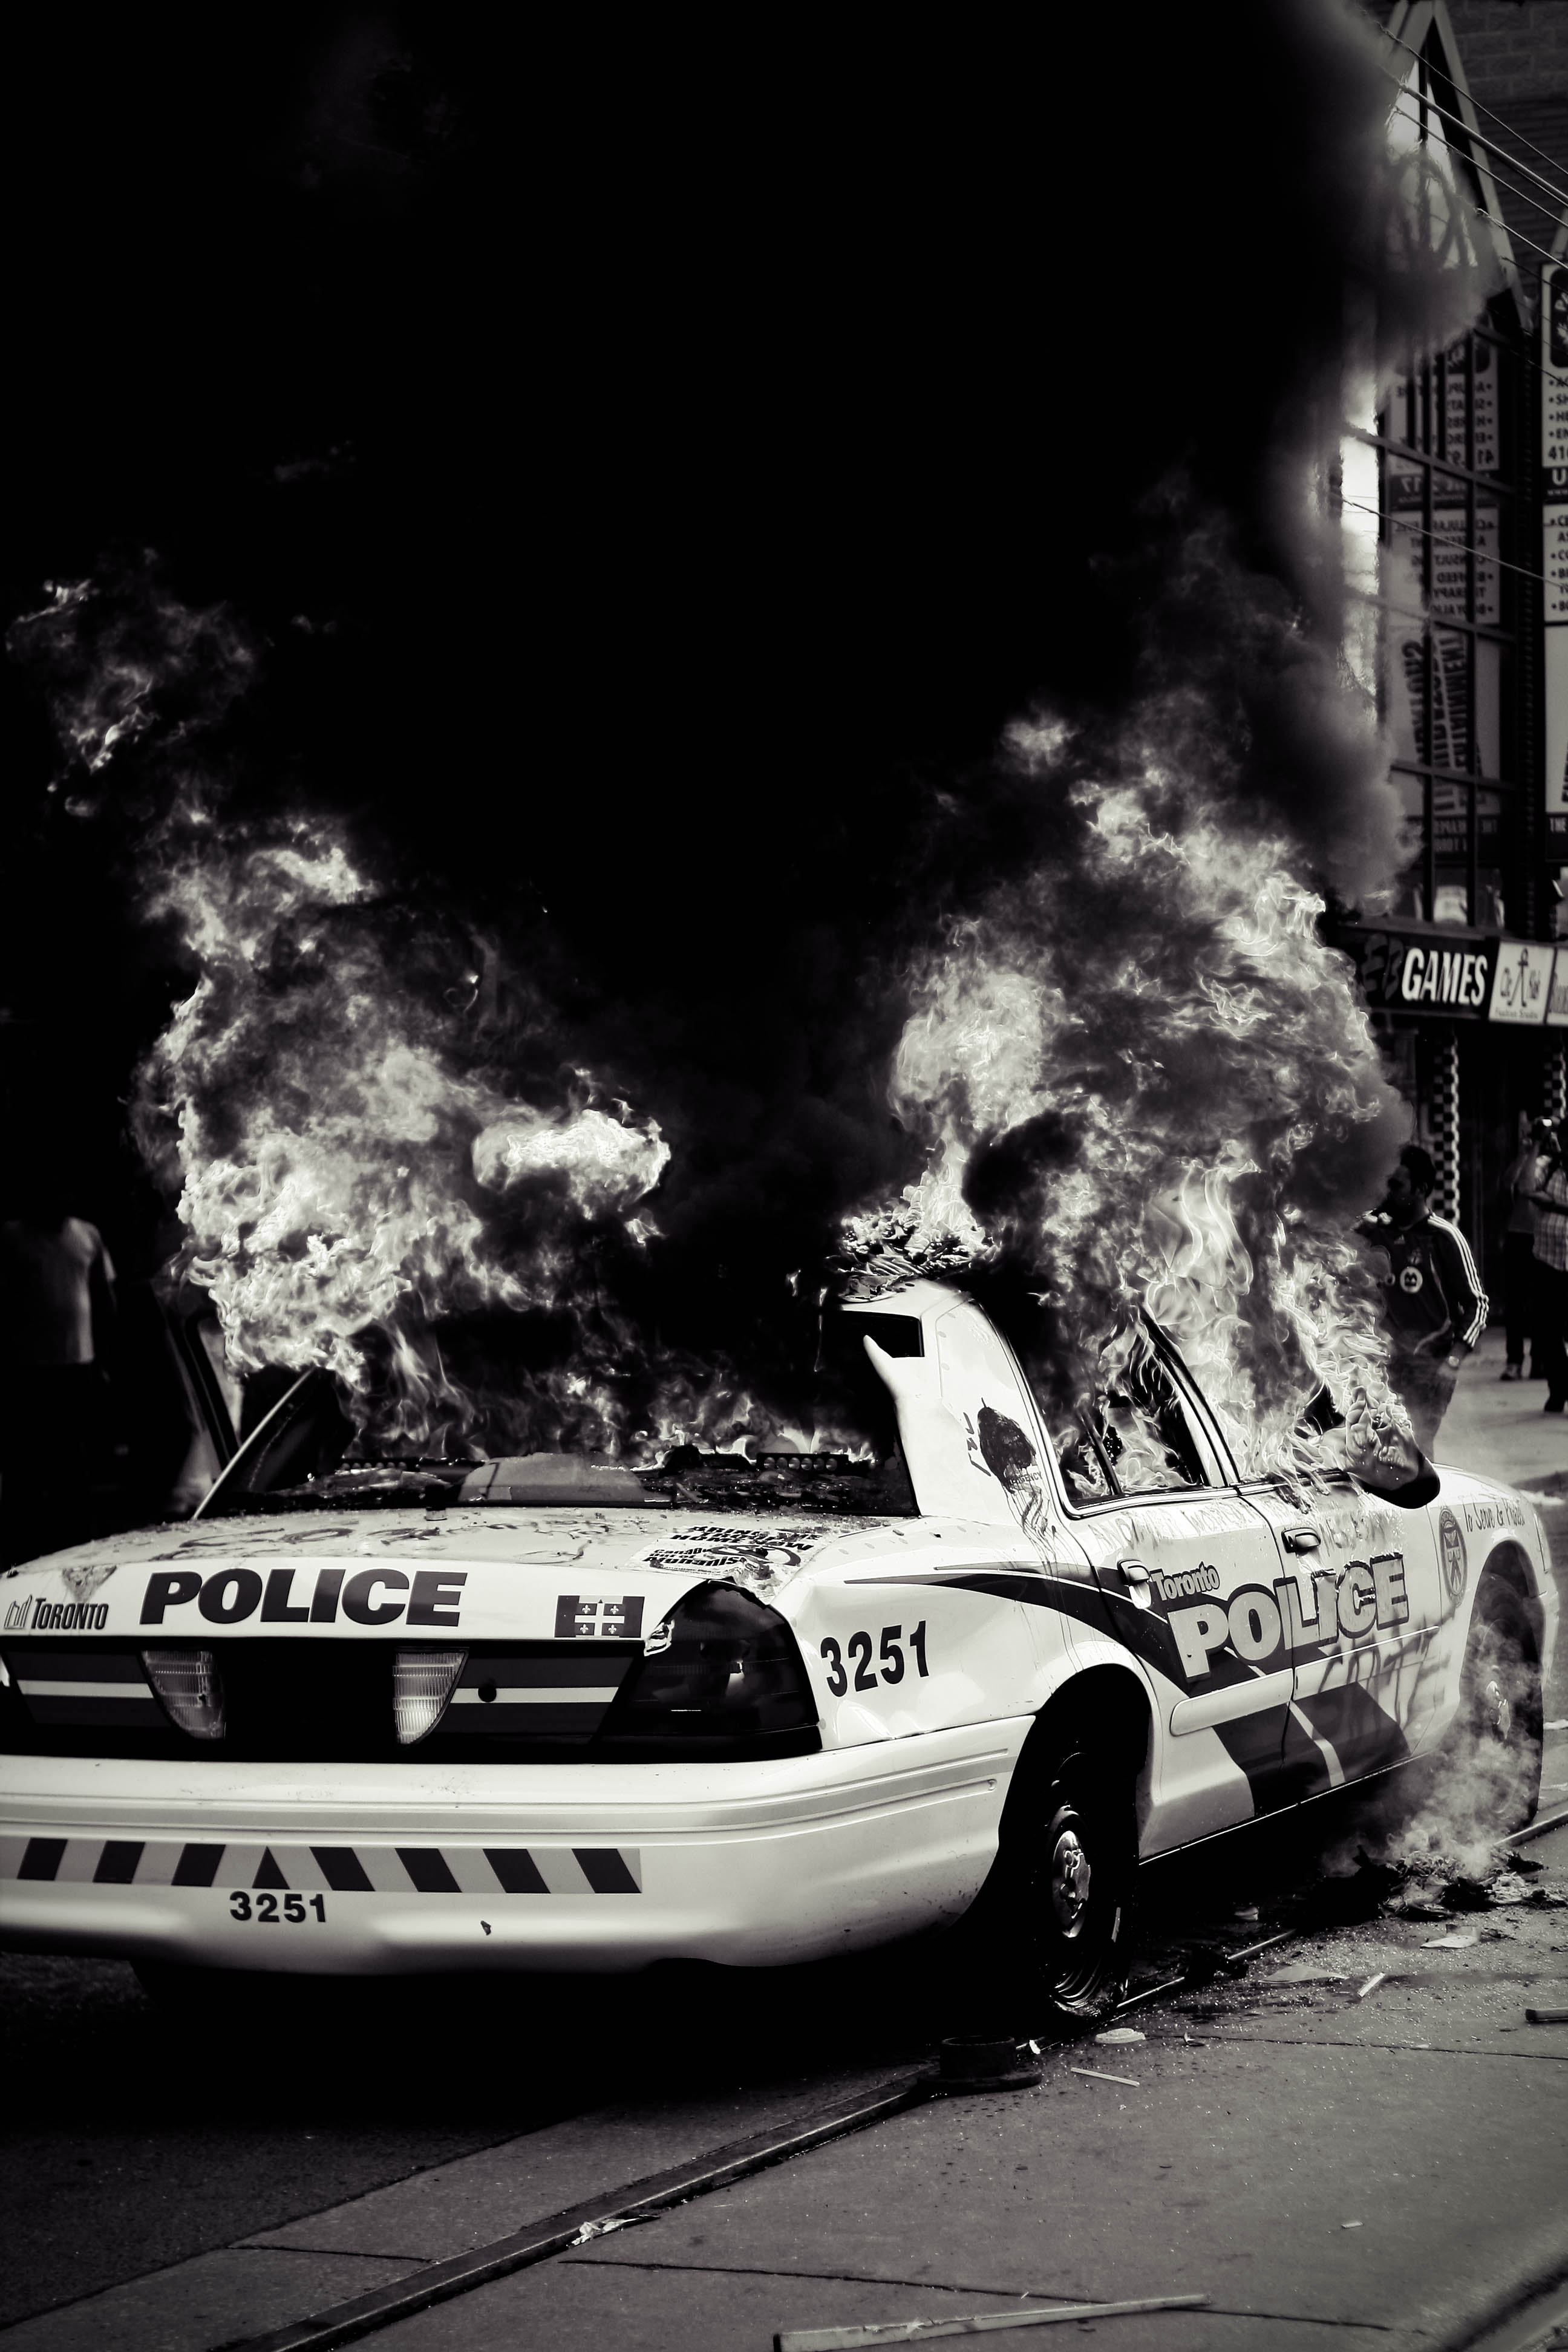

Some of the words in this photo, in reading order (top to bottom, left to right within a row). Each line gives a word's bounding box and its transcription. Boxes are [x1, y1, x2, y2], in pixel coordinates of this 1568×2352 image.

[1402, 947, 1488, 1007] GAMES
[139, 1568, 468, 1627] POLICE
[1151, 1561, 1220, 1601] Toronto
[31, 1597, 109, 1630] TORONTO
[1168, 1552, 1409, 1679] POLICE
[820, 1620, 929, 1697] 3251
[229, 1891, 326, 1923] 3251
